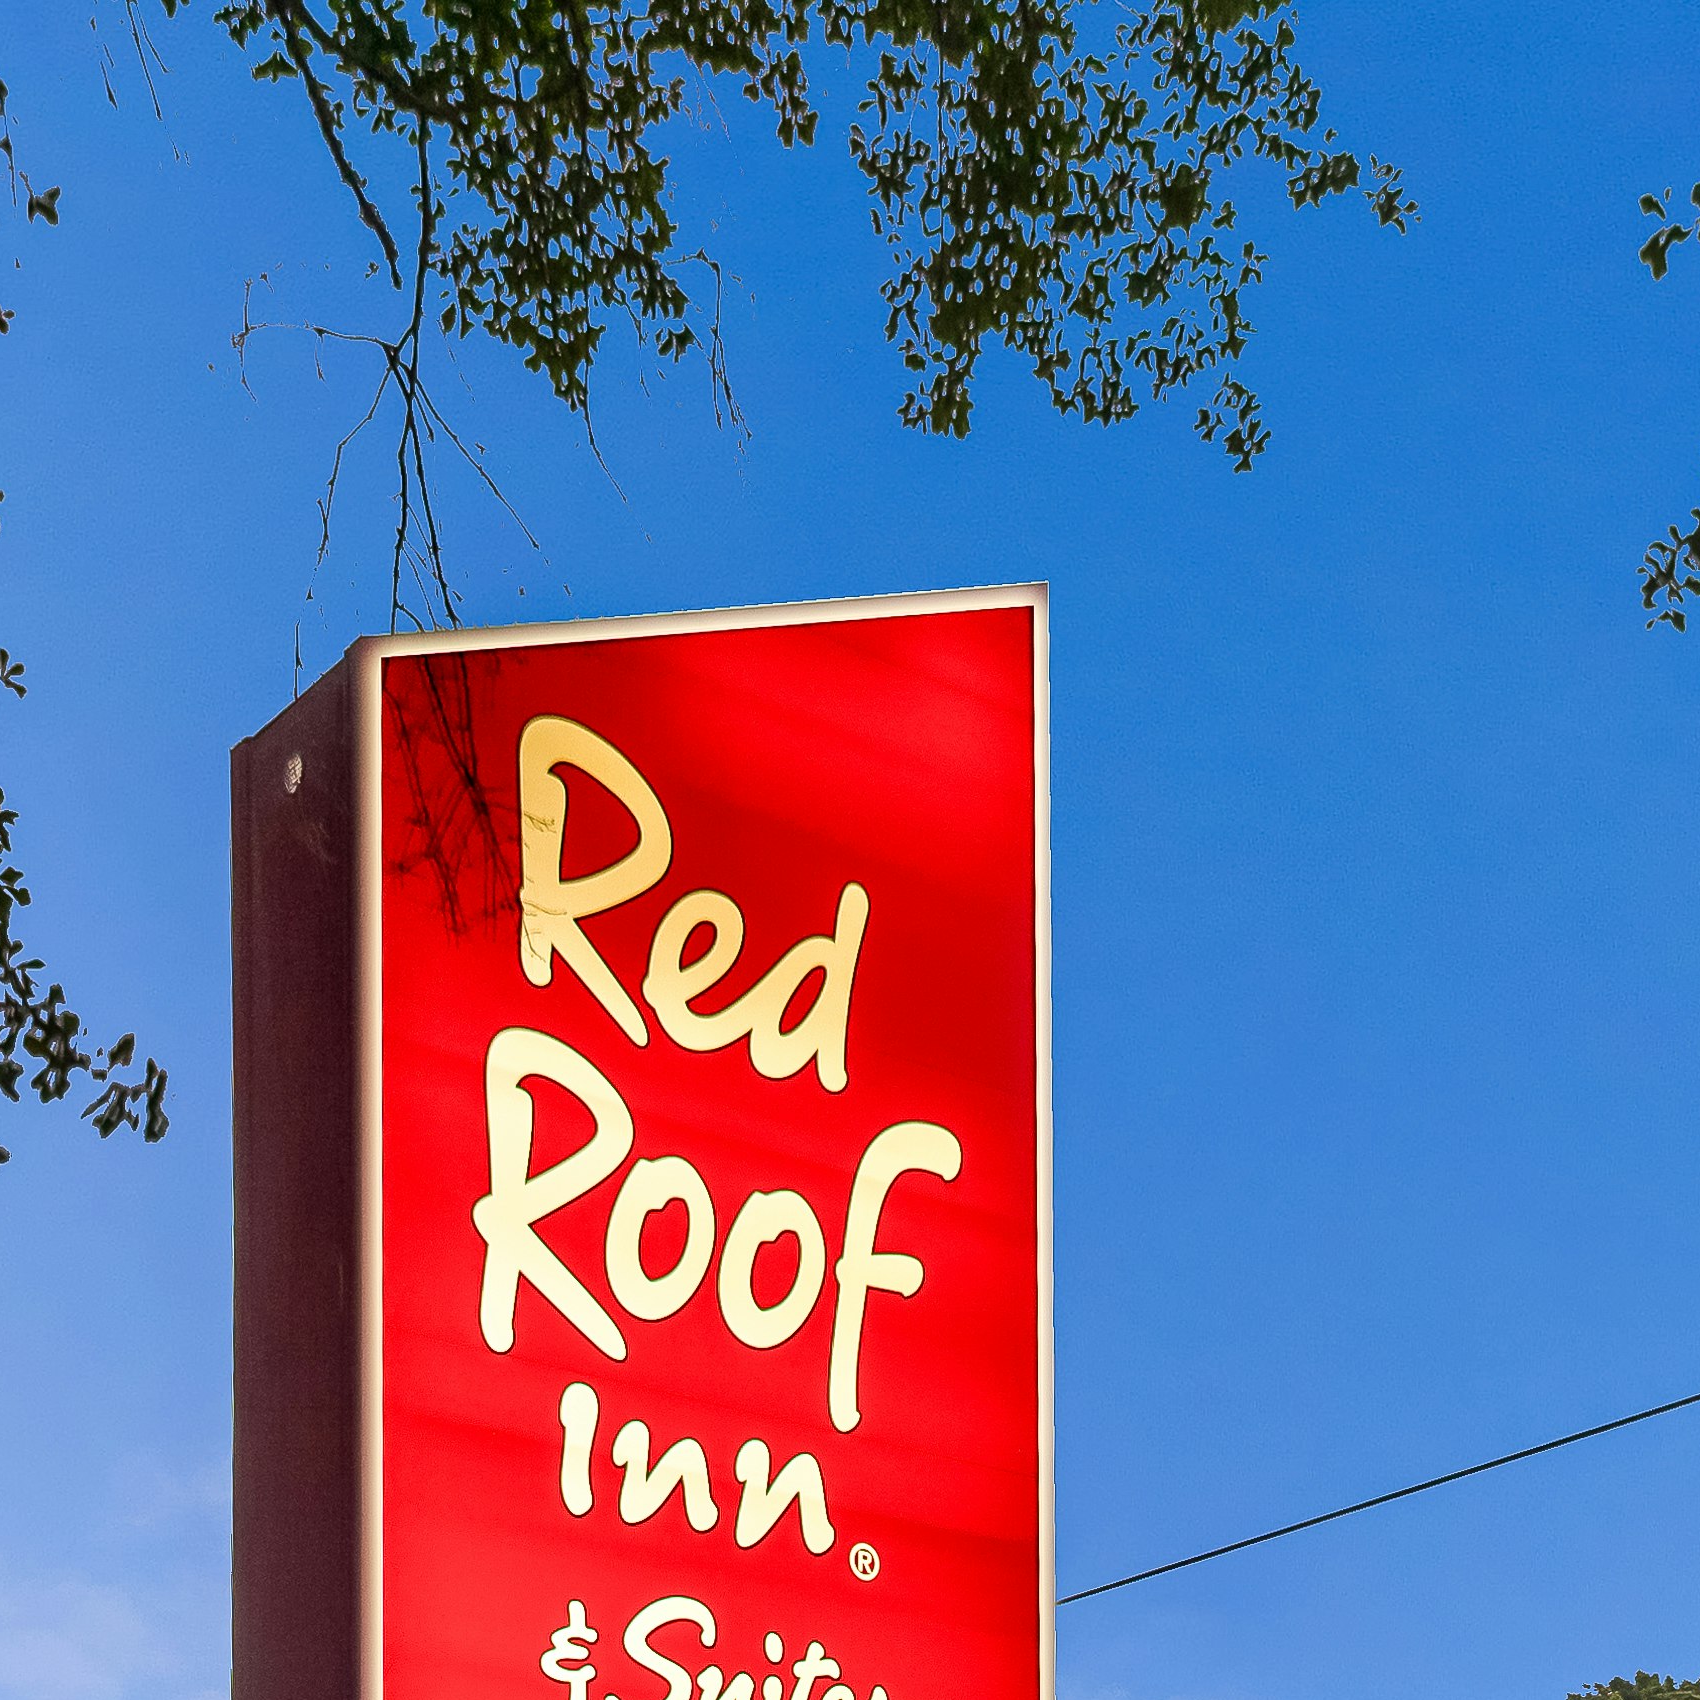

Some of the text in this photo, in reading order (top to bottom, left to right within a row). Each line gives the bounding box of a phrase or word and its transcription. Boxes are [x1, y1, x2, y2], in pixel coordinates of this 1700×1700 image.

[518, 714, 871, 1094] Red
[471, 1026, 963, 1434] Roof
[558, 1381, 836, 1555] Inn
